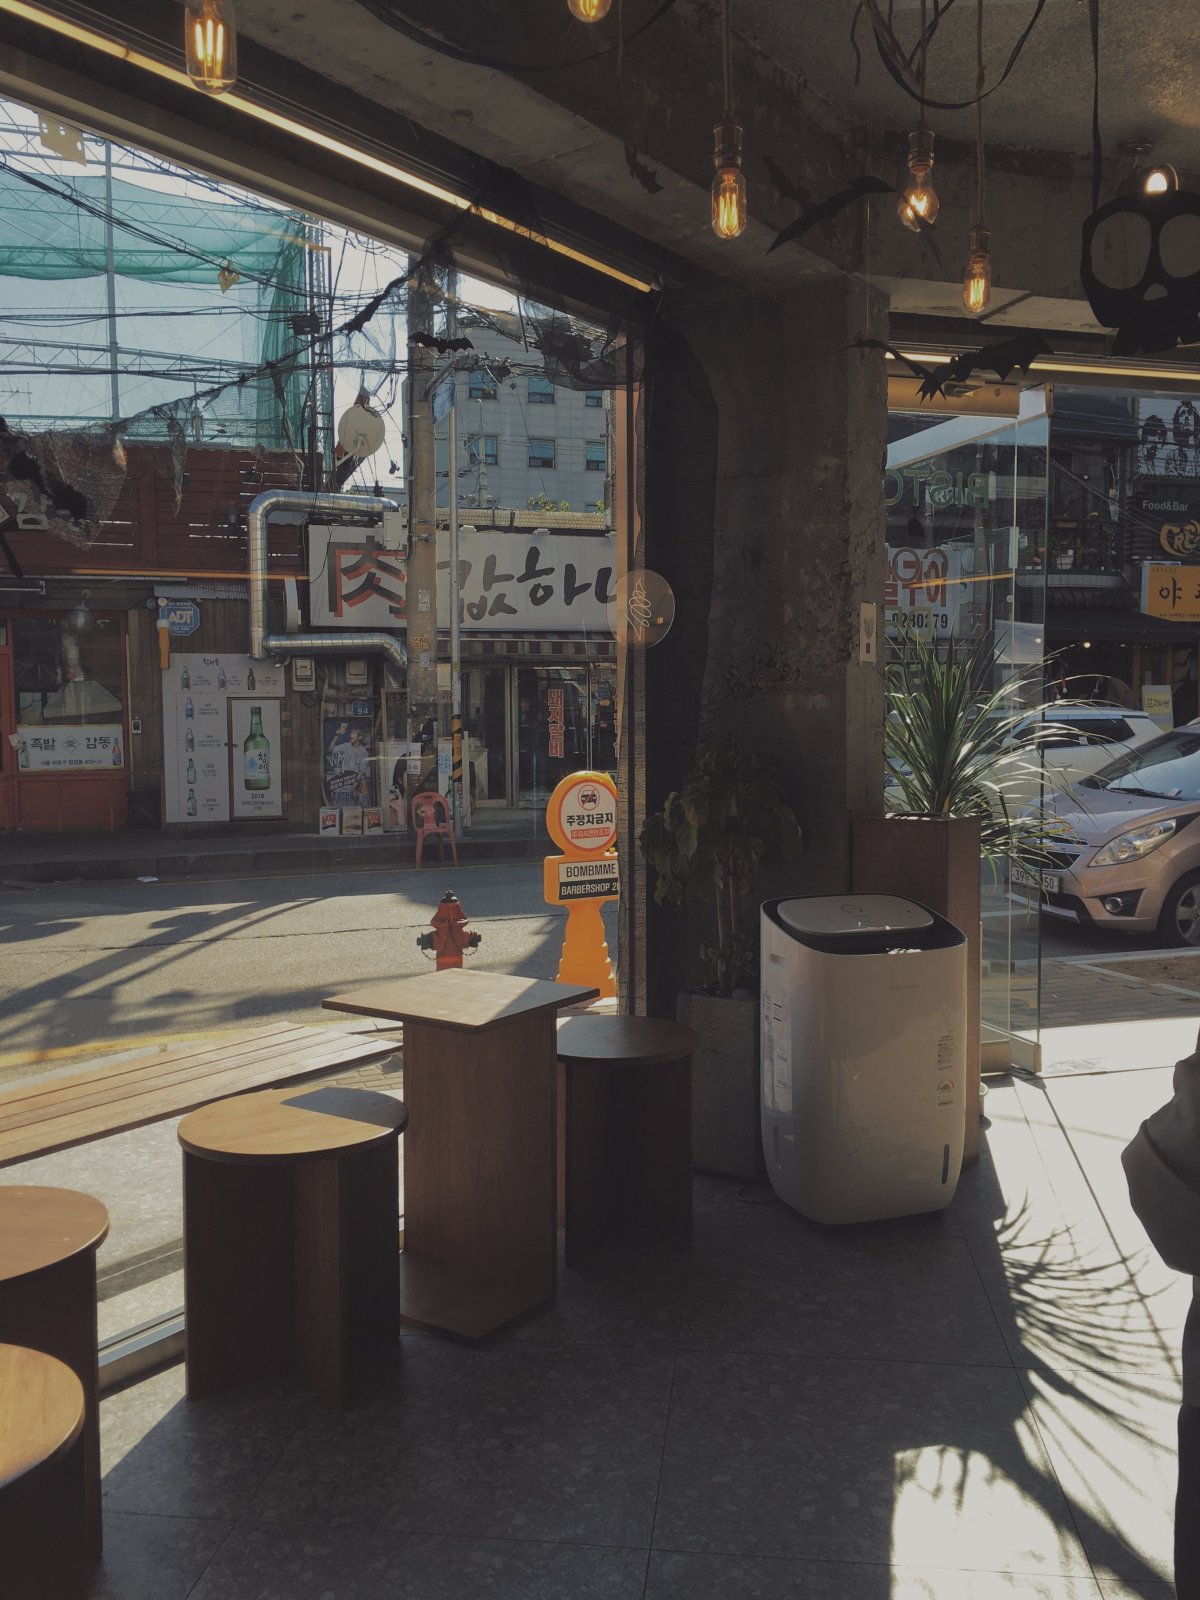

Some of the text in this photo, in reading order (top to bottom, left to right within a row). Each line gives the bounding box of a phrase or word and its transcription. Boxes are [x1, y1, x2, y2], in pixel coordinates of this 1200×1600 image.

[1142, 500, 1188, 511] Food&Bar
[169, 611, 193, 623] ADT
[357, 707, 369, 715] 94
[547, 688, 565, 758] 돼지갈비
[30, 737, 56, 751] 족발
[85, 736, 111, 749] 감동
[566, 812, 613, 826] 주정차금지
[566, 863, 616, 878] BOMBMME
[561, 882, 610, 896] BARBERSHOP
